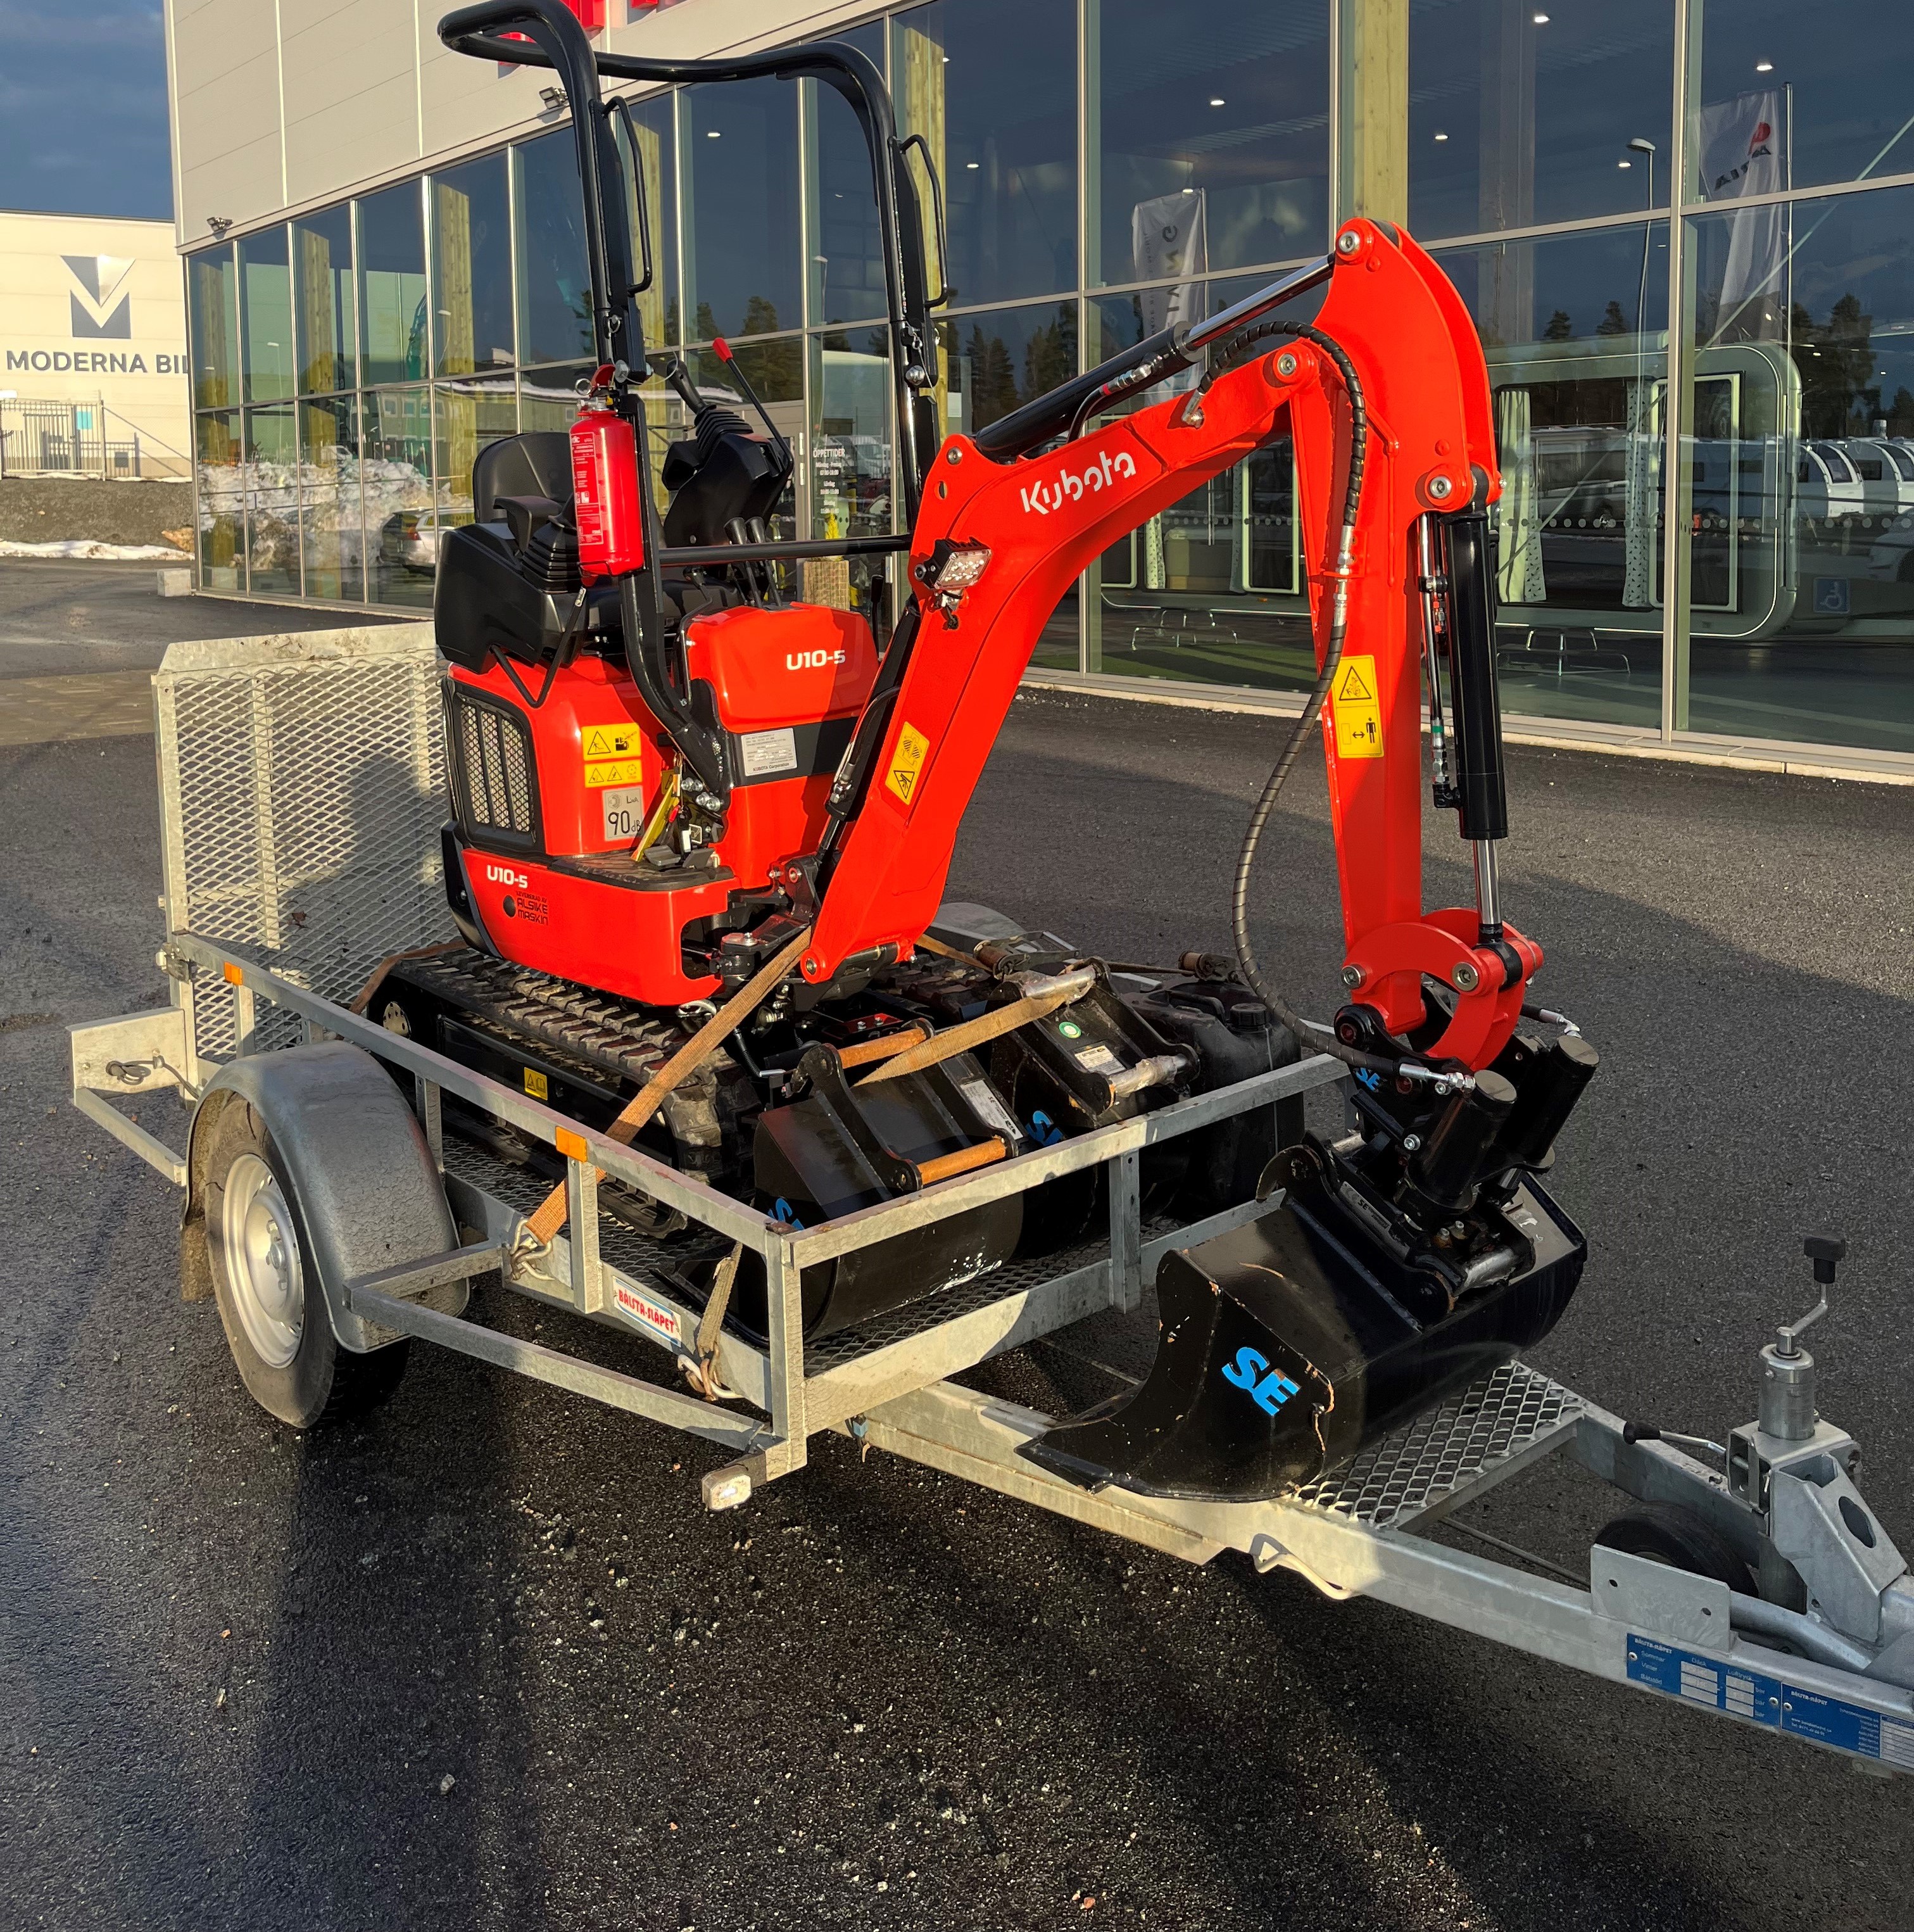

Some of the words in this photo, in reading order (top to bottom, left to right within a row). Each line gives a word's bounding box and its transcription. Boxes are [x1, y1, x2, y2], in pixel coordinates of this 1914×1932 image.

[6, 350, 148, 373] MODERNA
[1020, 450, 1137, 515] Kubota
[786, 649, 847, 671] U10-5
[487, 864, 528, 888] U10-5
[517, 897, 548, 914] ALSIKE
[517, 909, 549, 925] MASKIN
[619, 1289, 674, 1333] BÅLSTA-SLÄPET
[1221, 1346, 1301, 1416] SE
